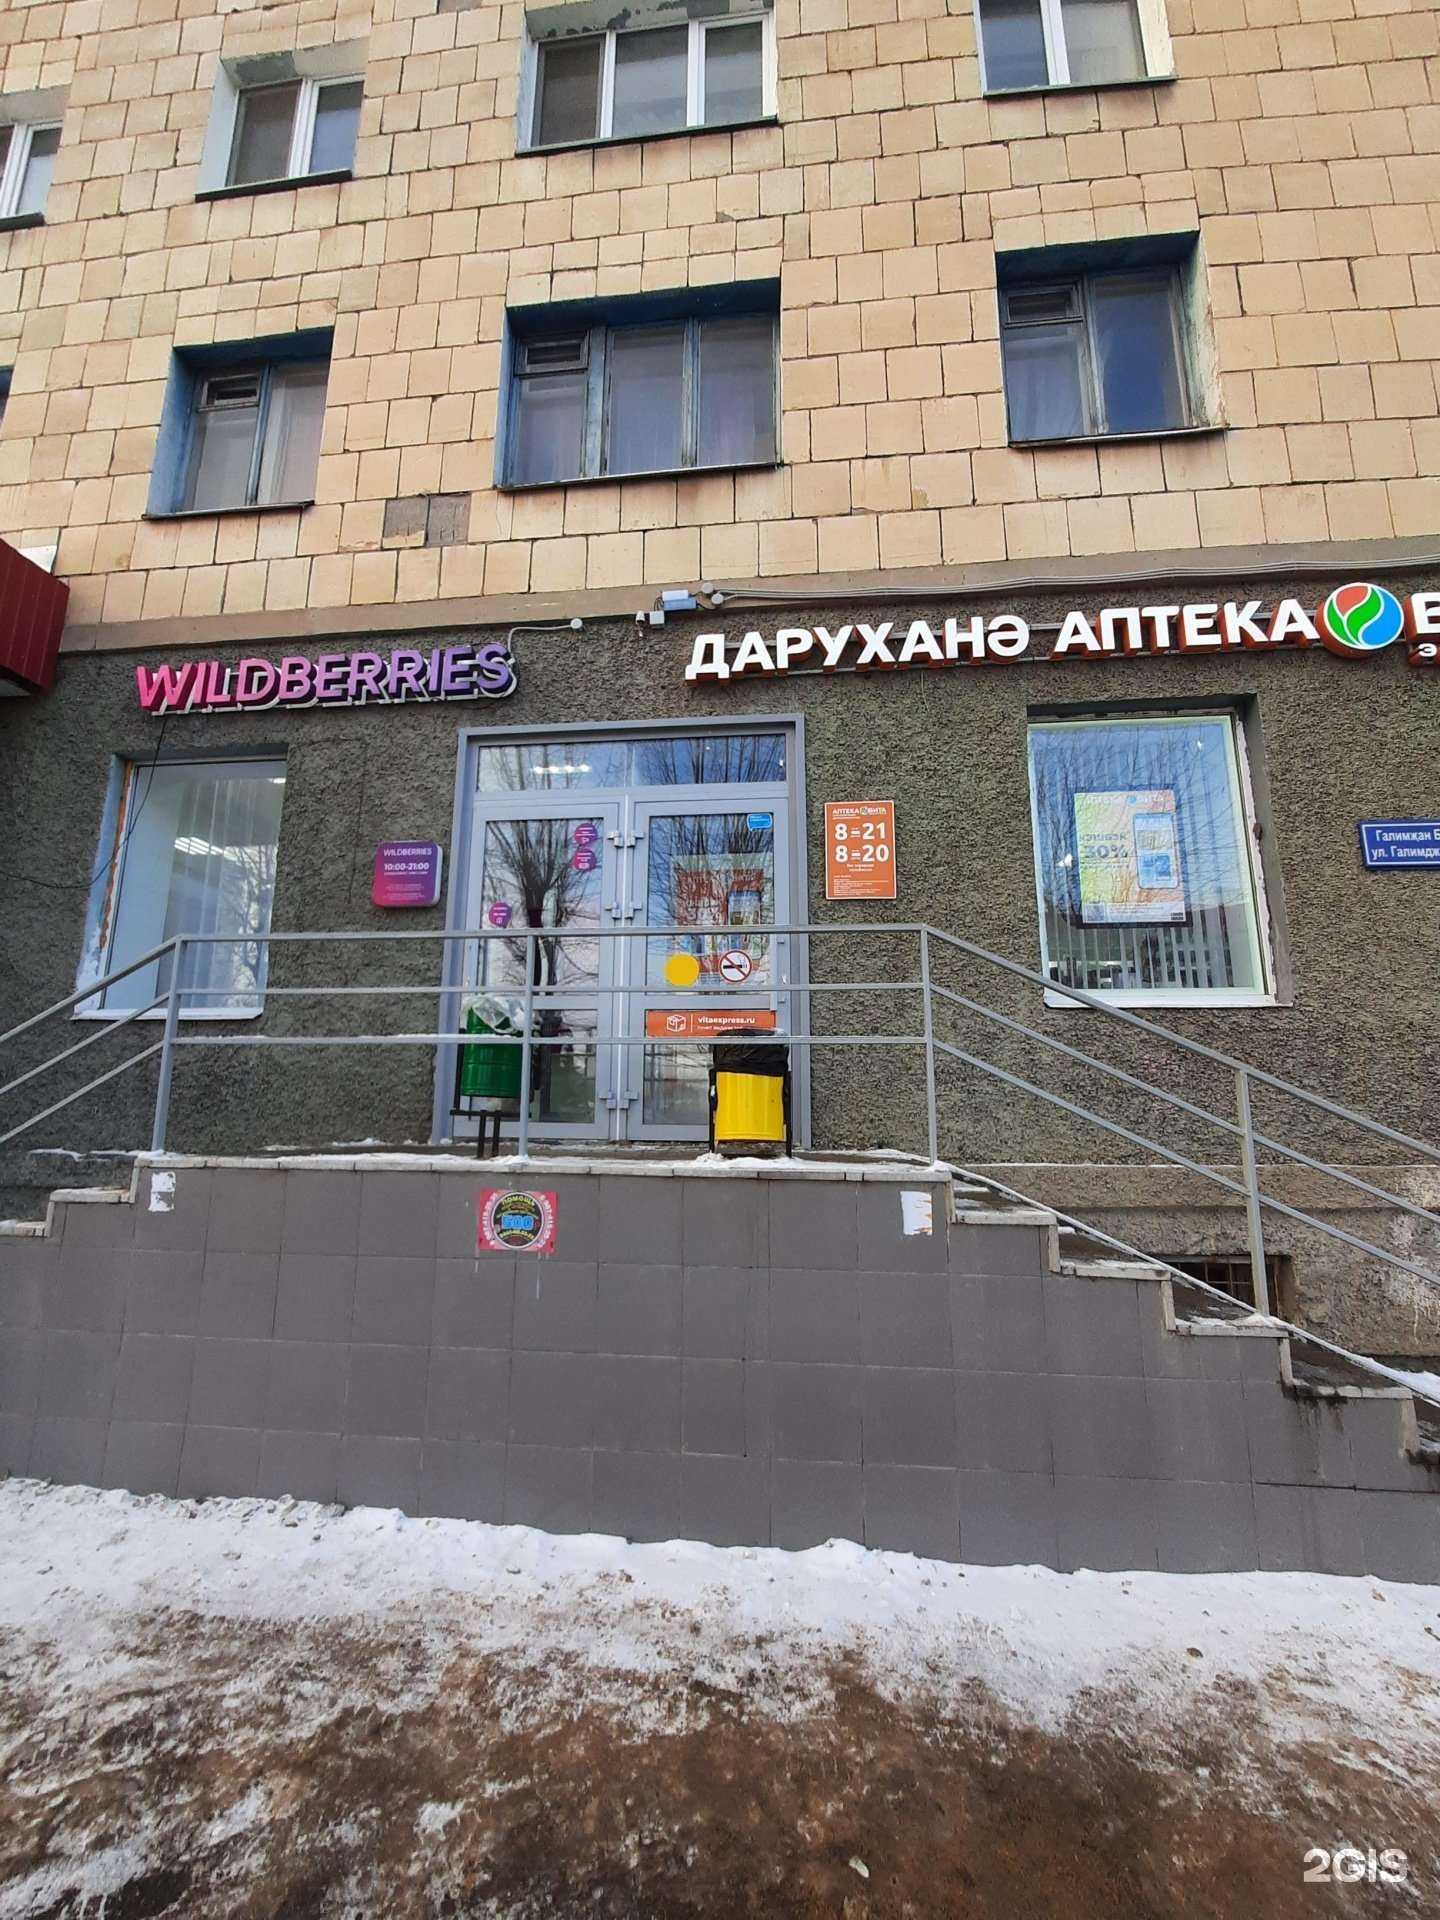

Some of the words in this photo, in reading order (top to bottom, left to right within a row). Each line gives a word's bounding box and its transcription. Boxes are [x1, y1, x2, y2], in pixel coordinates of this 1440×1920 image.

[684, 614, 1030, 681] ДАРУХАНӘ
[1054, 598, 1319, 653] АПТЕКА
[136, 643, 515, 712] WILDBERRIES
[383, 847, 433, 857] WILDBERRIES
[1371, 848, 1388, 861] ул.
[697, 1015, 756, 1026] vitaexpress.ru
